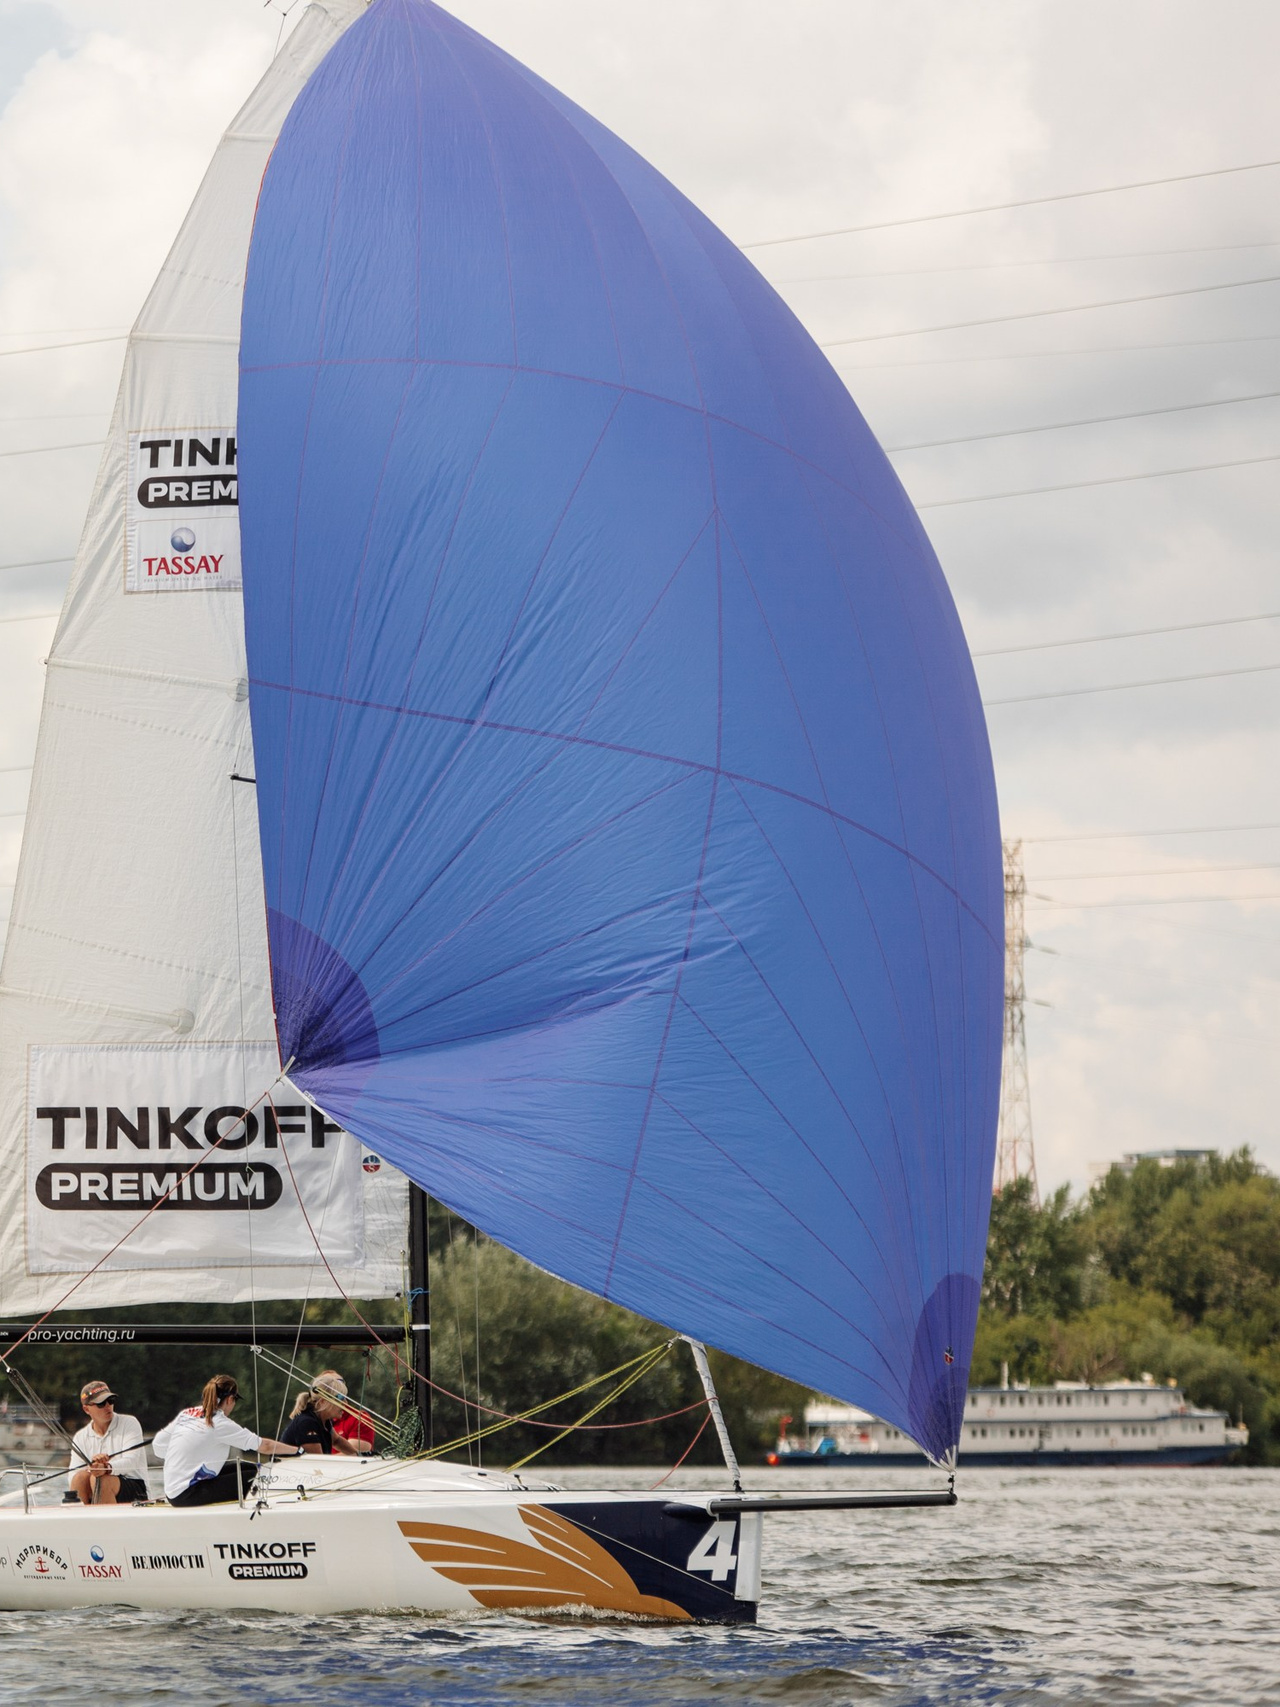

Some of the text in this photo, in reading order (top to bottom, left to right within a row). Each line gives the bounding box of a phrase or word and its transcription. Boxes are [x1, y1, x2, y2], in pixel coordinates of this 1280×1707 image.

[143, 555, 224, 576] TASSAY
[36, 1106, 346, 1150] TINKOFF
[51, 1172, 265, 1200] PREMIUM
[28, 1328, 135, 1343] pro-yachting.ru
[15, 1545, 68, 1570] МОРПРИБОР
[213, 1542, 317, 1559] TINKOFF
[686, 1521, 737, 1581] 4
[78, 1565, 122, 1578] TASSAY
[131, 1555, 205, 1570] ВЕДОМОСТИ
[232, 1565, 304, 1577] PREMIUM
